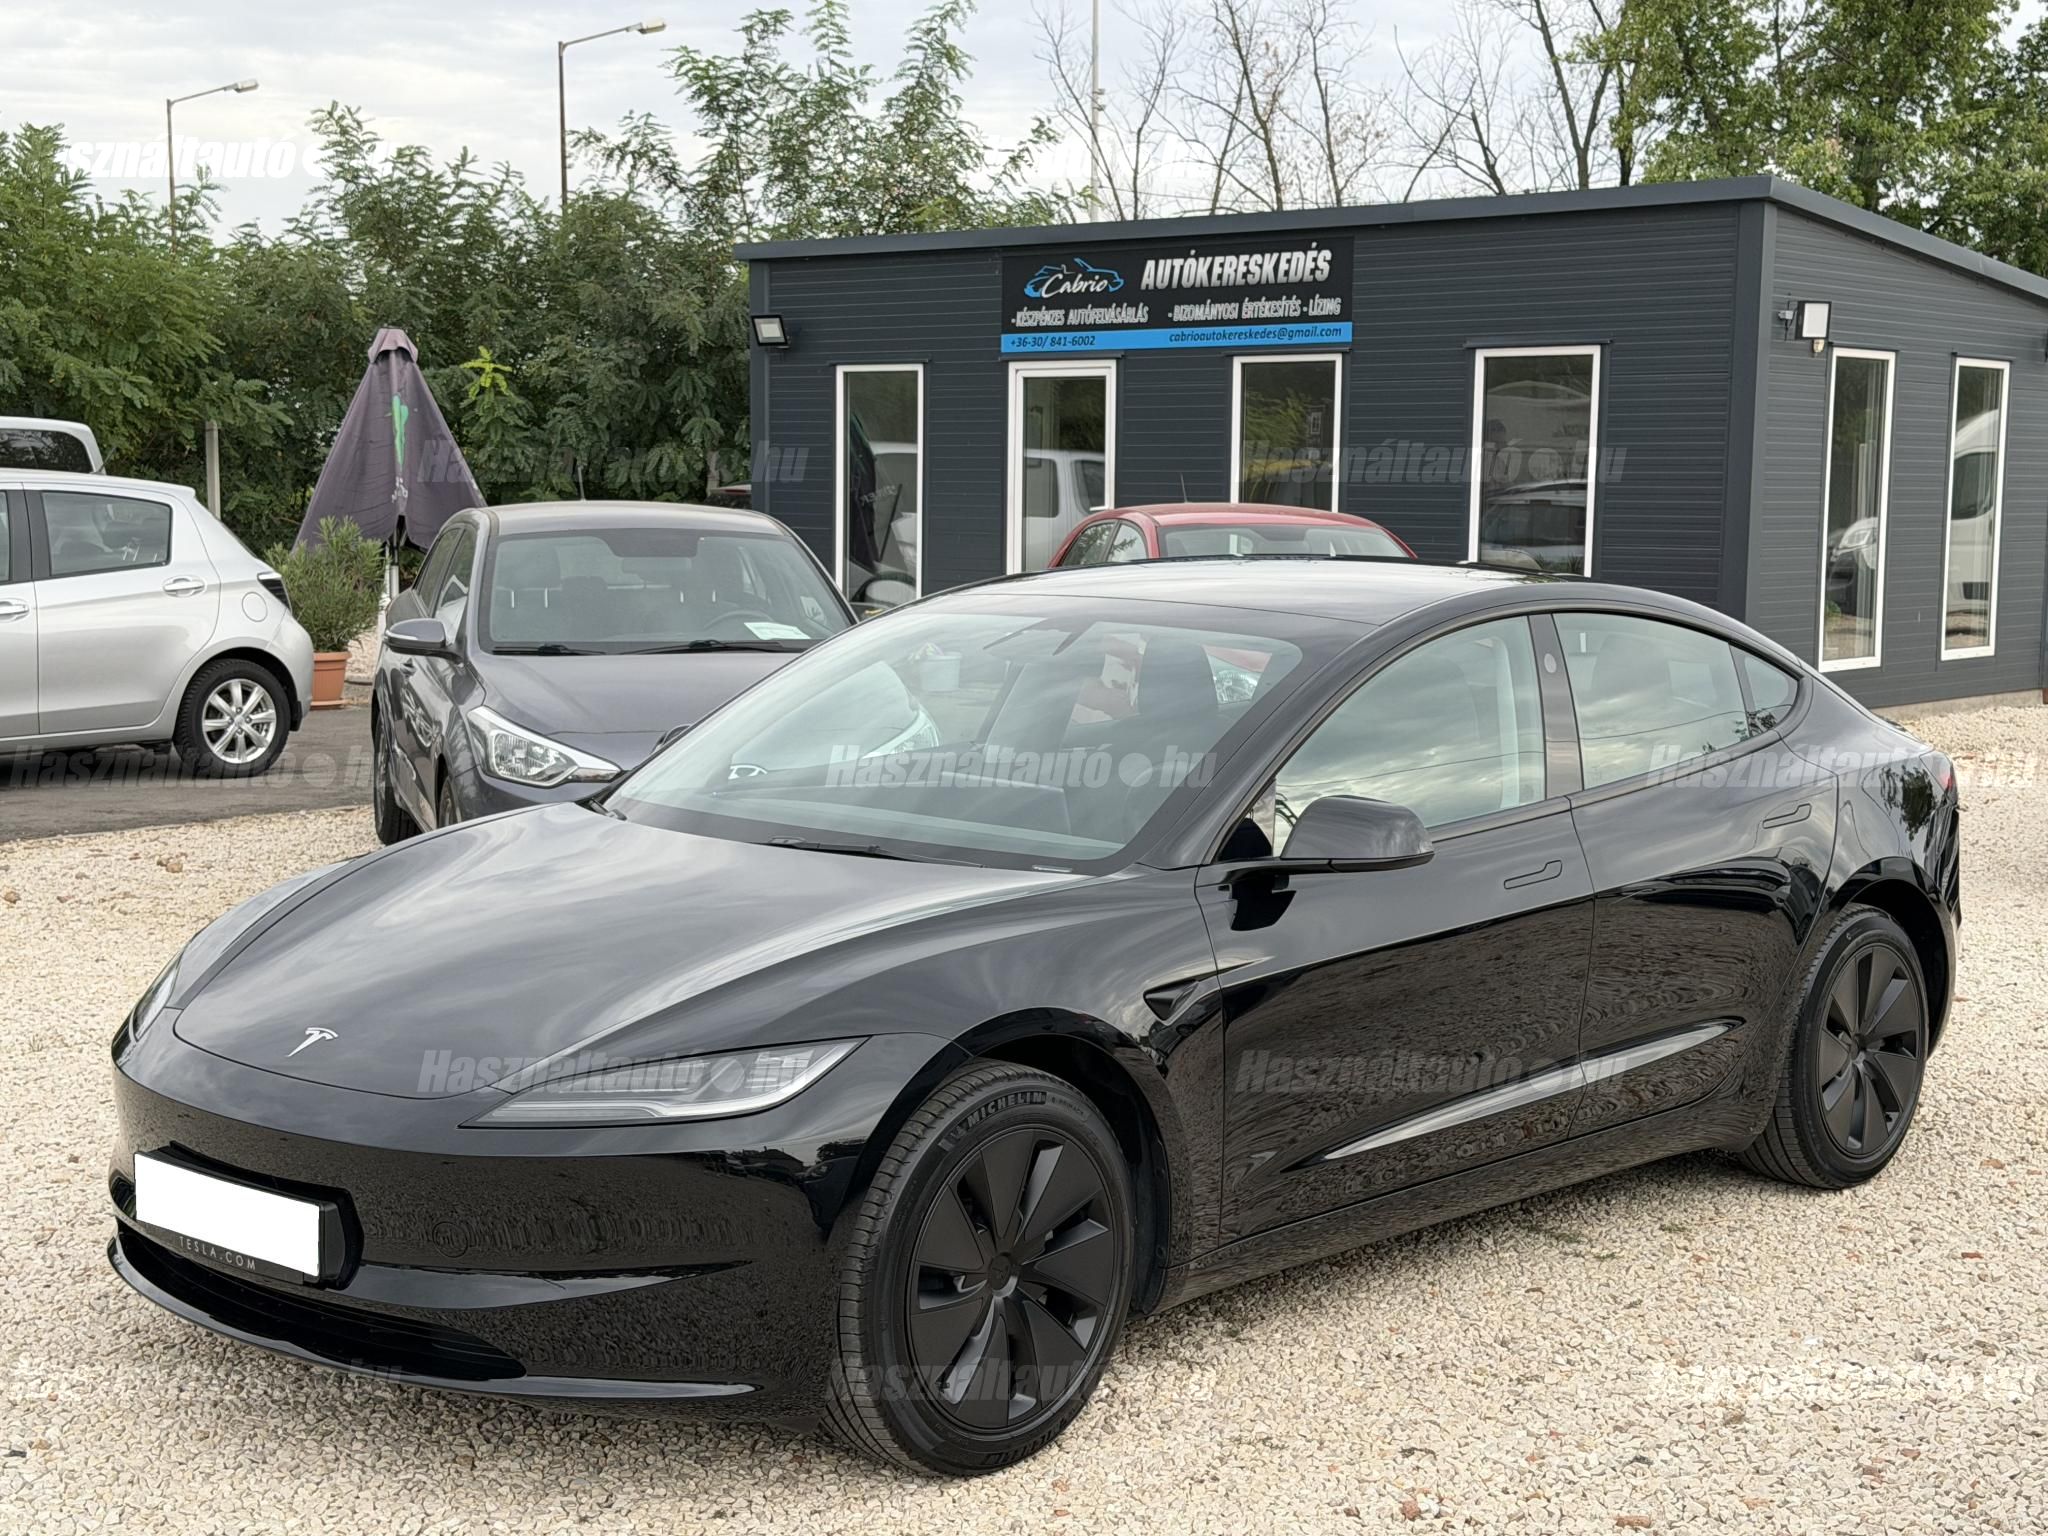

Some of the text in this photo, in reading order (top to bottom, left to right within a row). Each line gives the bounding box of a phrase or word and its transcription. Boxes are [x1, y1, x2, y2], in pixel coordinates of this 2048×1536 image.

[1139, 241, 1333, 291] AUTÓKERESKEDÉS
[1040, 272, 1109, 298] Cabrio
[1049, 335, 1096, 347] 841-6002
[1169, 325, 1342, 343] cabrioautokereskedes@gmail.com
[966, 1090, 1048, 1129] MICHELIN
[179, 1235, 256, 1271] TESLA.COM
